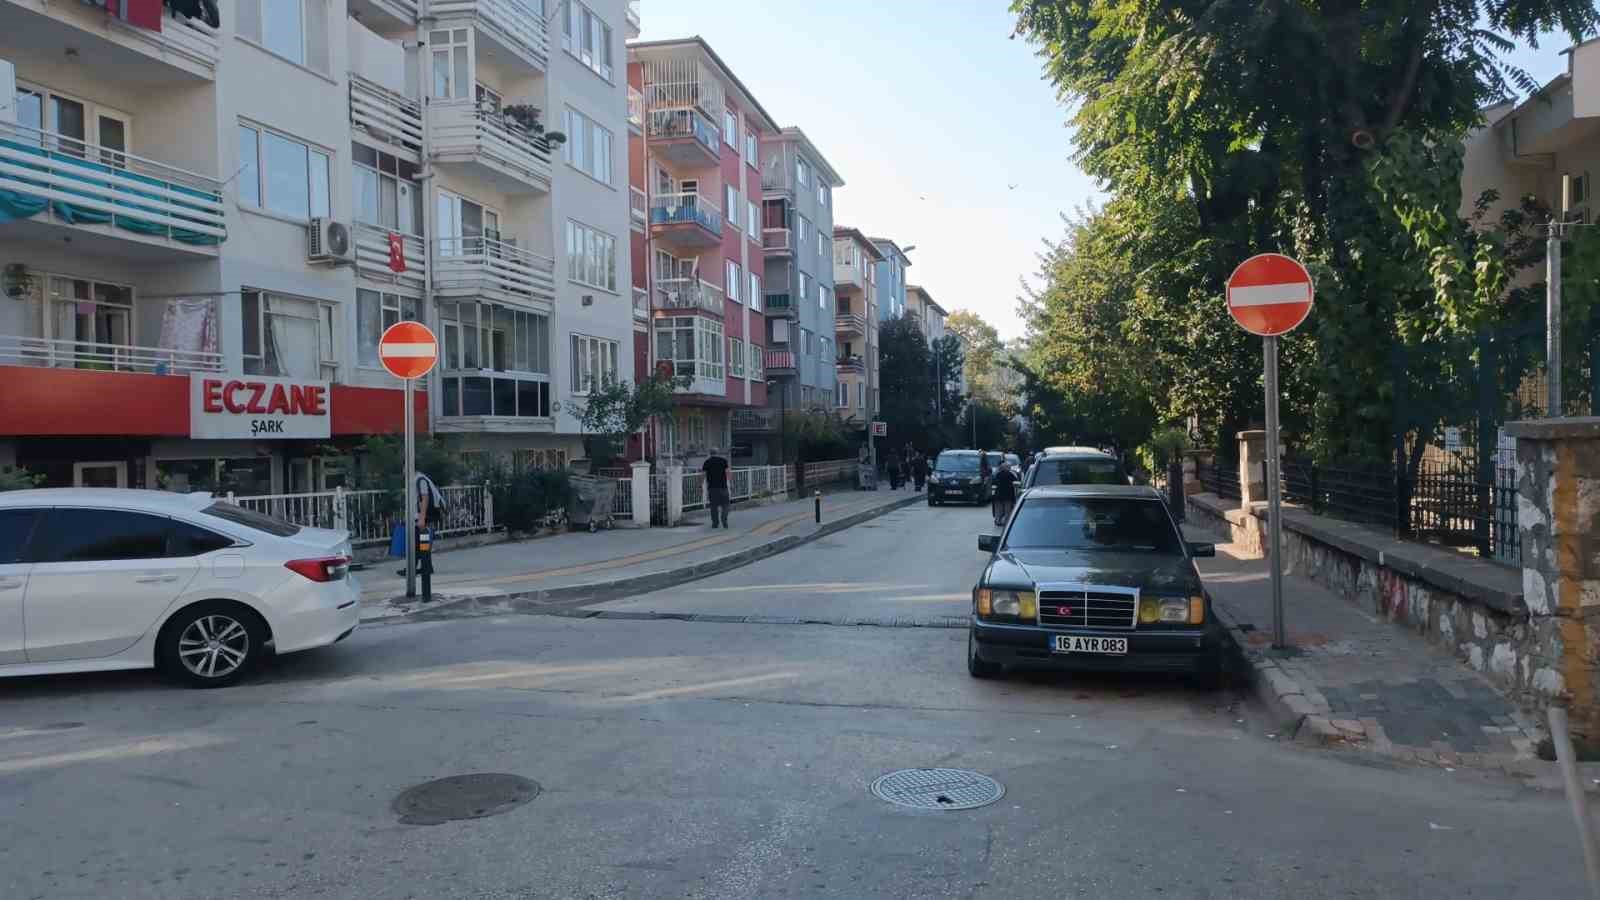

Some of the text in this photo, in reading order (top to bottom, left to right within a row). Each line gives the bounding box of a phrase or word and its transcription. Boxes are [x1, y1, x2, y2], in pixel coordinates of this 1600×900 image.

[203, 379, 326, 416] ECZANE
[251, 419, 284, 437] ŞARK
[1057, 636, 1071, 649] 16
[1074, 638, 1099, 651] AYR
[1101, 638, 1126, 652] 083
